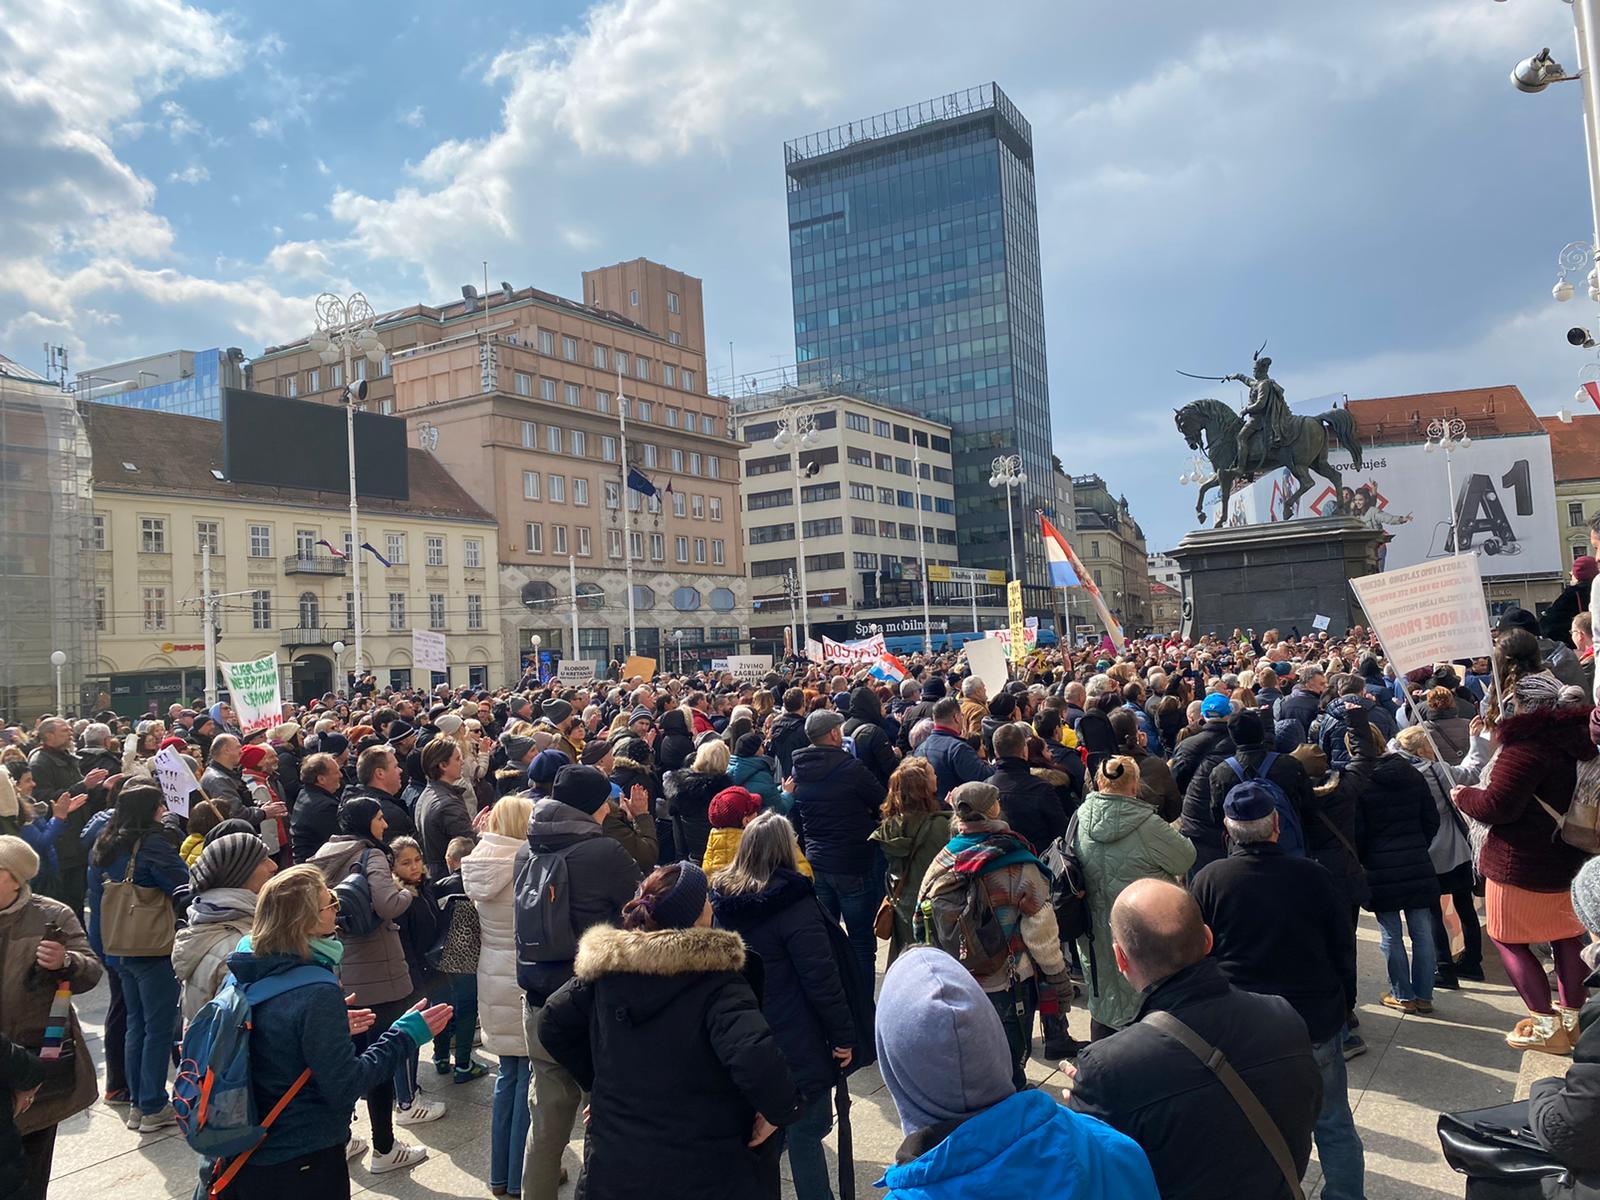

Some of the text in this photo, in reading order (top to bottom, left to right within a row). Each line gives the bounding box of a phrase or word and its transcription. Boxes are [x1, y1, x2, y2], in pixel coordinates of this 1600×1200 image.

[1331, 457, 1387, 471] oveuješ
[1444, 459, 1533, 553] A1
[855, 621, 884, 636] Špia
